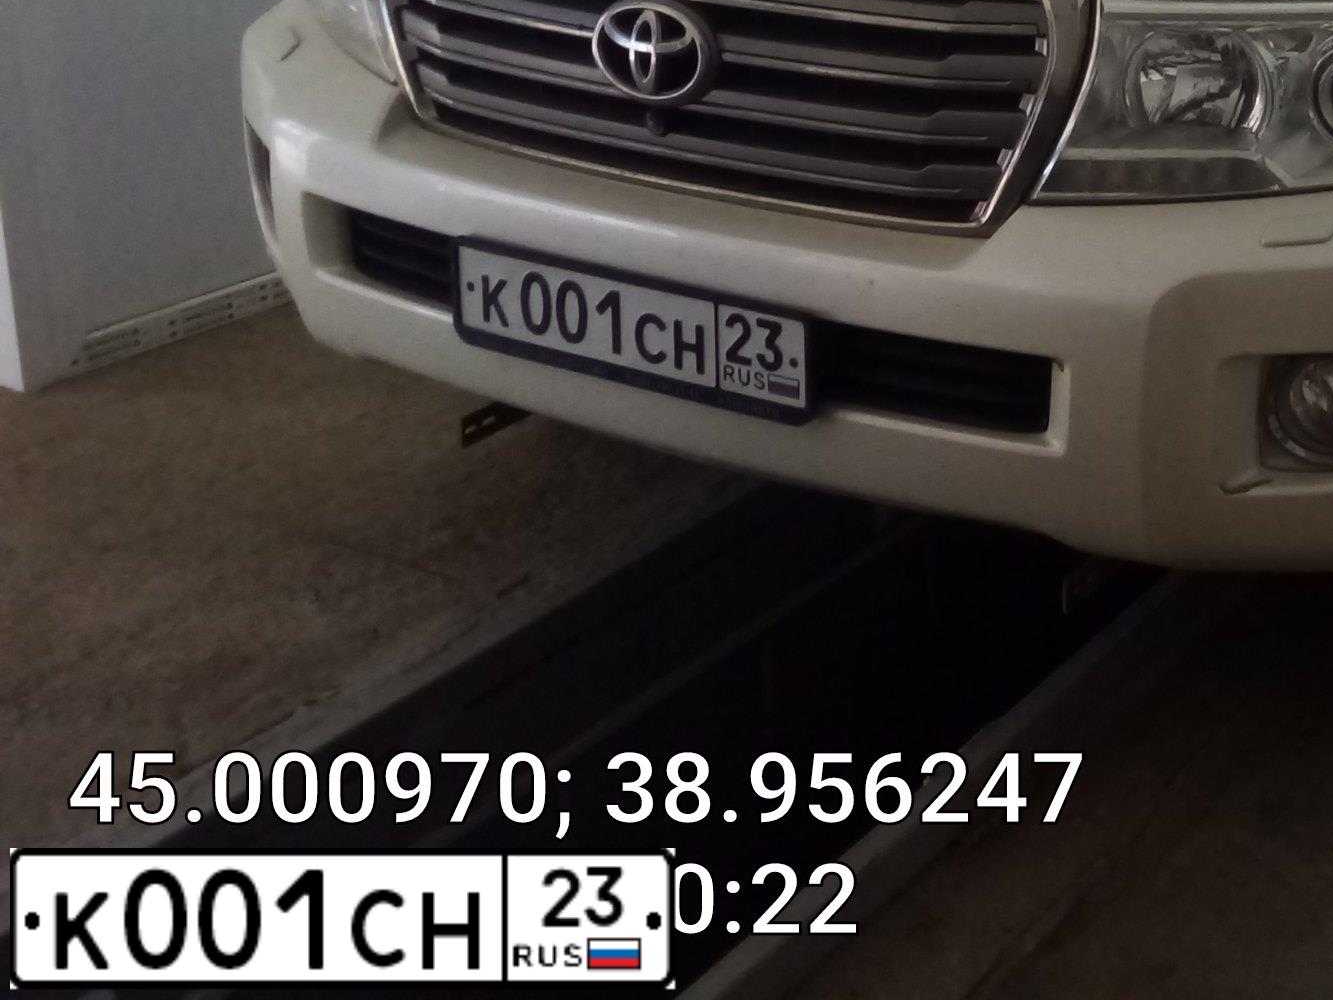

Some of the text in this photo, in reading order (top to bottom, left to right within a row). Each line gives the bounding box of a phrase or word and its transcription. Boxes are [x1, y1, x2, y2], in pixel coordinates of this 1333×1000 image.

[480, 270, 784, 376] K001CH 23
[722, 364, 767, 391] RUS
